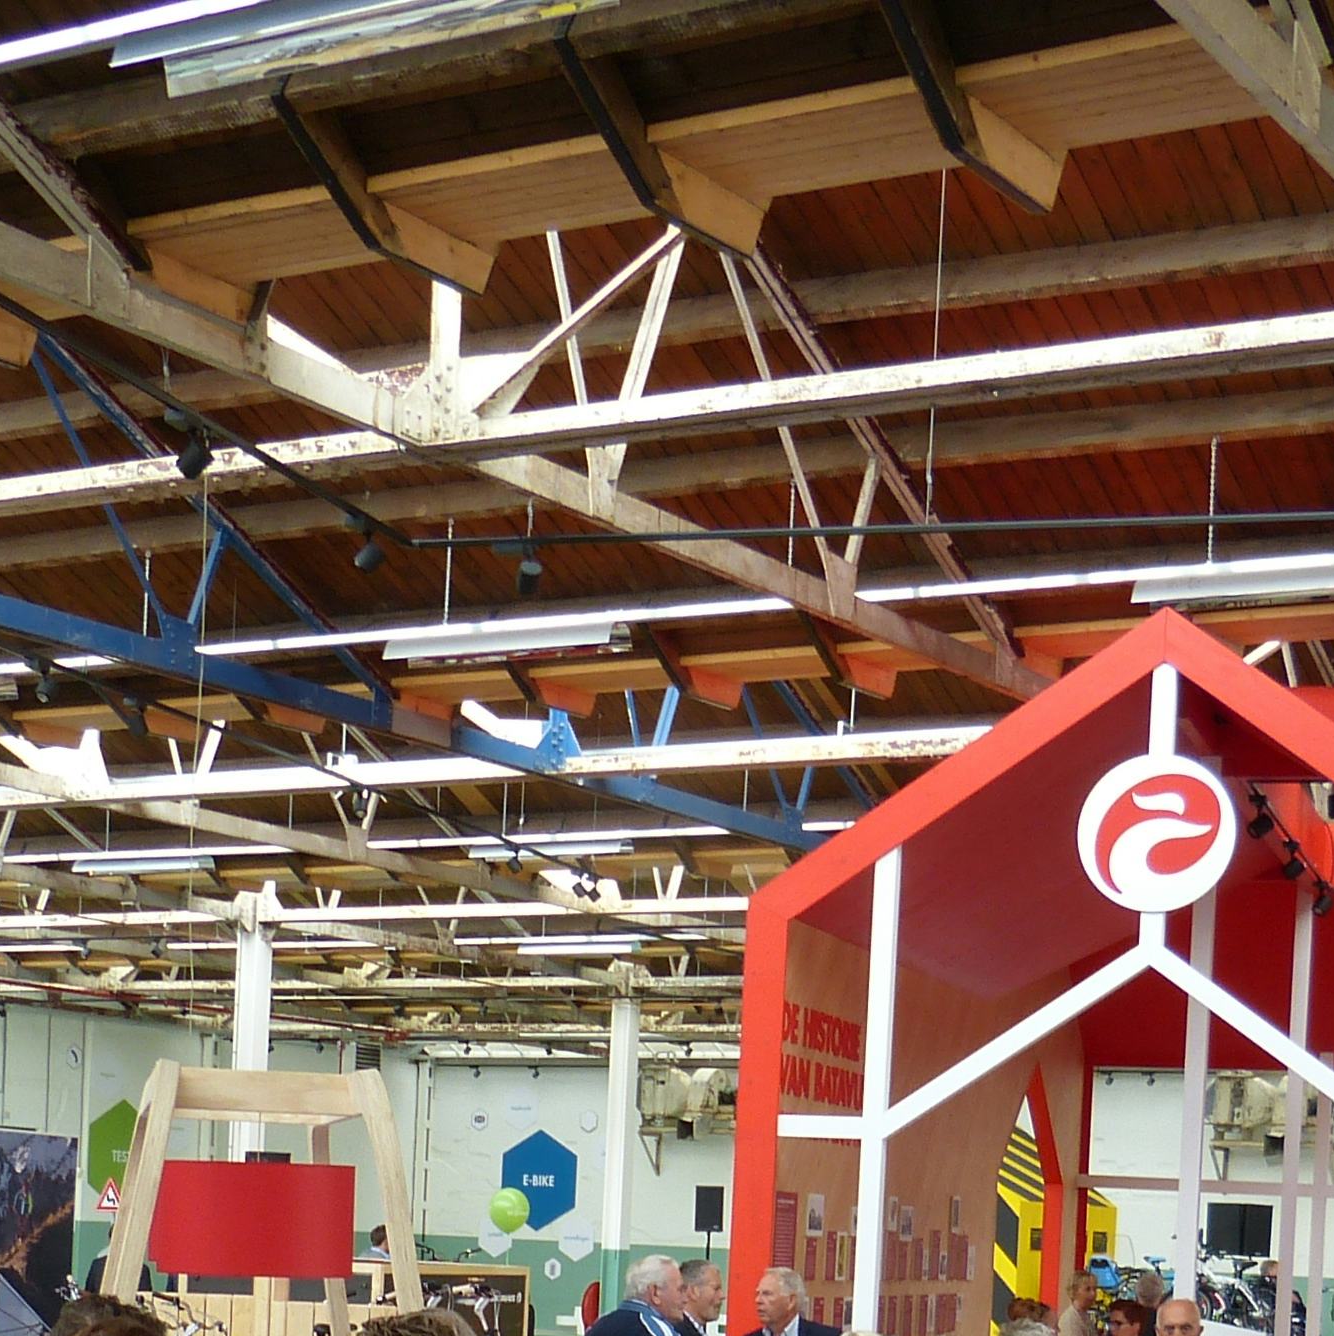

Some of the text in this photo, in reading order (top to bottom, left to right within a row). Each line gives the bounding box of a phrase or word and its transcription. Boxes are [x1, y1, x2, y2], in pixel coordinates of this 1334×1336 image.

[782, 1001, 862, 1062] DE HISTORIE
[780, 1053, 865, 1111] VAN BATAVU
[112, 1149, 130, 1163] TES
[522, 1173, 556, 1188] E-BIKE
